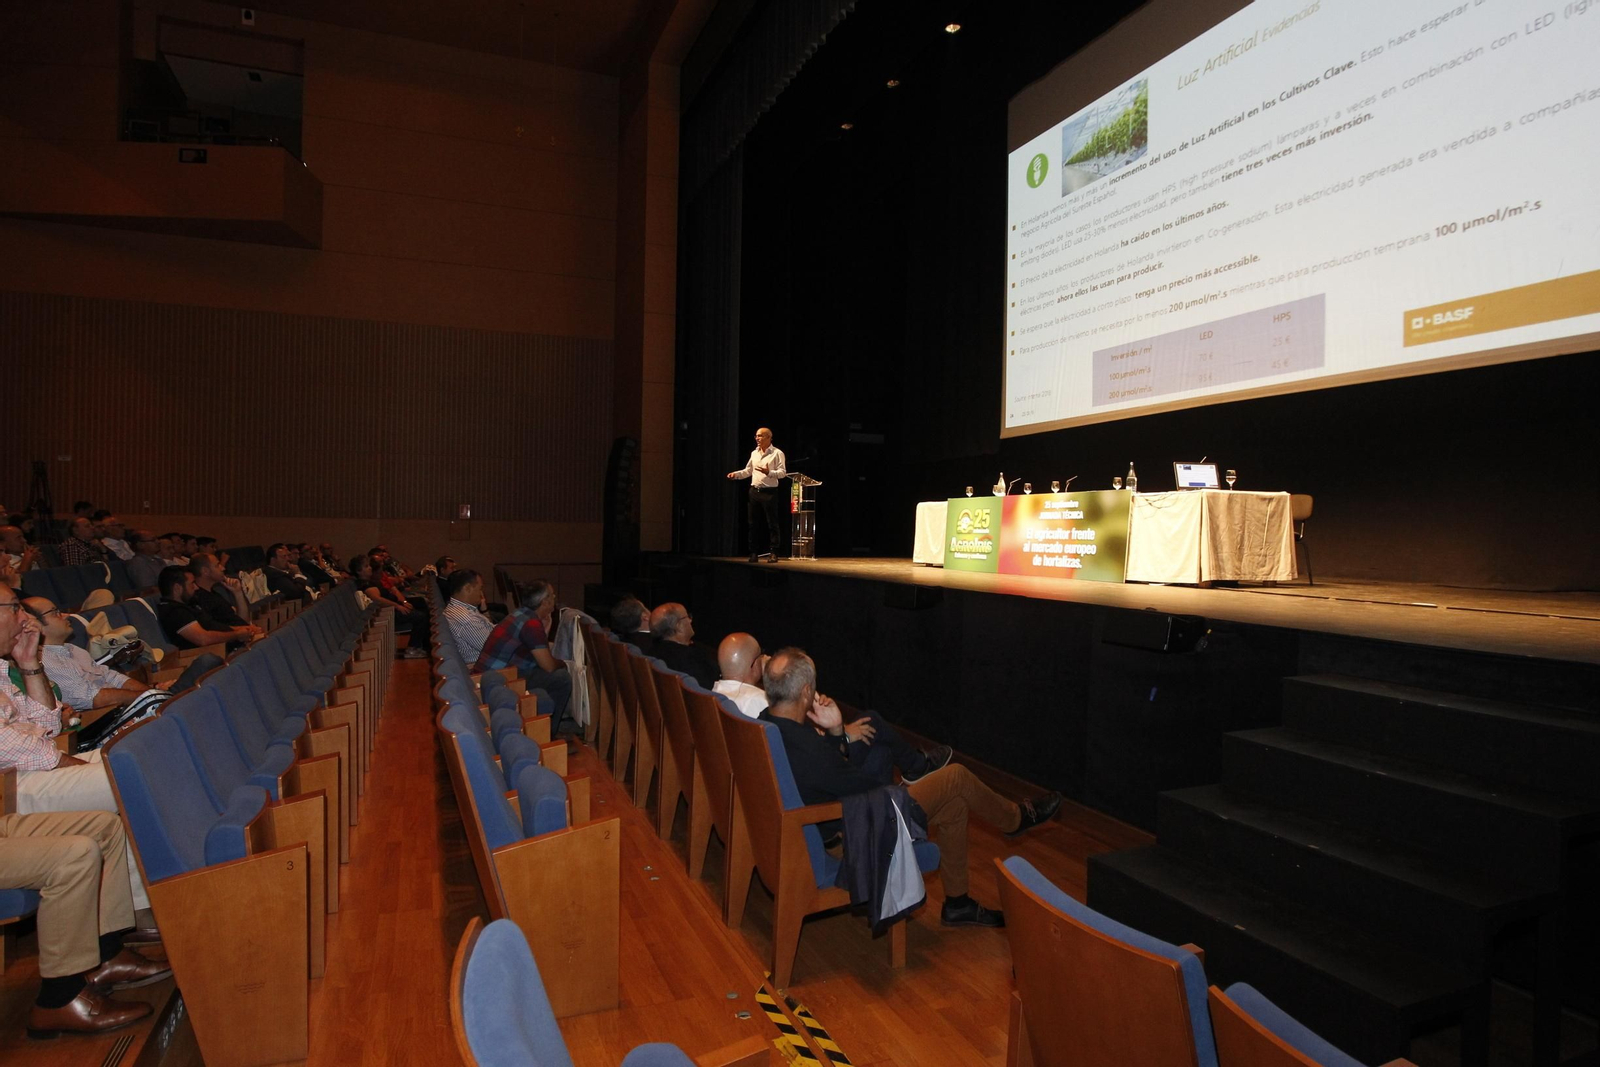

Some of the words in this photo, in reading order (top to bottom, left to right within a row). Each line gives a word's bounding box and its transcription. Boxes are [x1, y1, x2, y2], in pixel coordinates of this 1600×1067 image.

[1178, 70, 1199, 90] Luz
[1203, 32, 1257, 76] Artificial
[1262, 0, 1320, 43] Evidencias
[1109, 162, 1147, 185] incremento
[1149, 153, 1161, 166] del
[1163, 147, 1177, 159] uso
[1179, 141, 1189, 151] de
[1192, 133, 1205, 145] Luz
[1209, 112, 1245, 137] Artificial
[1248, 107, 1259, 118] en
[1263, 98, 1276, 111] los
[1279, 77, 1320, 103] Cultivos
[1324, 60, 1357, 81] Clave.
[1361, 45, 1384, 63] Esto
[1389, 29, 1416, 50] hace
[1421, 3, 1469, 34] esperar
[1104, 200, 1141, 223] productores
[1324, 115, 1331, 127] y
[1335, 110, 1341, 119] a
[1402, 47, 1484, 90] combinación
[1491, 31, 1518, 51] con
[1525, 11, 1555, 35] LED
[1062, 240, 1072, 250] LED
[1222, 167, 1244, 182] tiene
[1246, 159, 1263, 172] tres
[1266, 146, 1293, 164] veces
[1296, 136, 1316, 151] más
[1320, 113, 1374, 141] inversión.
[1081, 267, 1115, 286] productores
[1297, 176, 1354, 206] electricidad
[1359, 157, 1413, 187] generada
[1418, 148, 1437, 162] era
[1443, 126, 1497, 153] vendida
[1504, 121, 1512, 132] a
[1121, 239, 1129, 248] ha
[1152, 227, 1161, 236] en
[1163, 222, 1173, 232] los
[1175, 210, 1205, 227] últimos
[1207, 201, 1229, 214] años.
[1135, 288, 1156, 300] tenga
[1158, 284, 1167, 293] un
[1169, 275, 1192, 291] precio
[1195, 269, 1212, 281] más
[1214, 254, 1261, 275] accessible.
[1169, 301, 1184, 313] 200
[1435, 222, 1458, 238] 100
[1057, 293, 1074, 304] ahora
[1075, 288, 1088, 297] ellos
[1100, 279, 1115, 289] usan
[1117, 273, 1132, 285] para
[1133, 261, 1164, 280] producir.
[1273, 311, 1292, 324] HPS
[1433, 306, 1474, 325] BASF
[1199, 330, 1214, 341] LED
[974, 509, 990, 528] 25
[1063, 510, 1083, 519] TÉCNICA
[1026, 528, 1033, 538] El
[1035, 528, 1070, 541] agricultor
[1072, 528, 1095, 540] frente
[1023, 541, 1030, 552] al
[1032, 542, 1063, 553] mercado
[1064, 544, 1096, 556] europeo
[1033, 555, 1042, 566] de
[1043, 555, 1082, 568] hortalizas.
[604, 830, 610, 840] 2
[286, 860, 294, 871] 3
